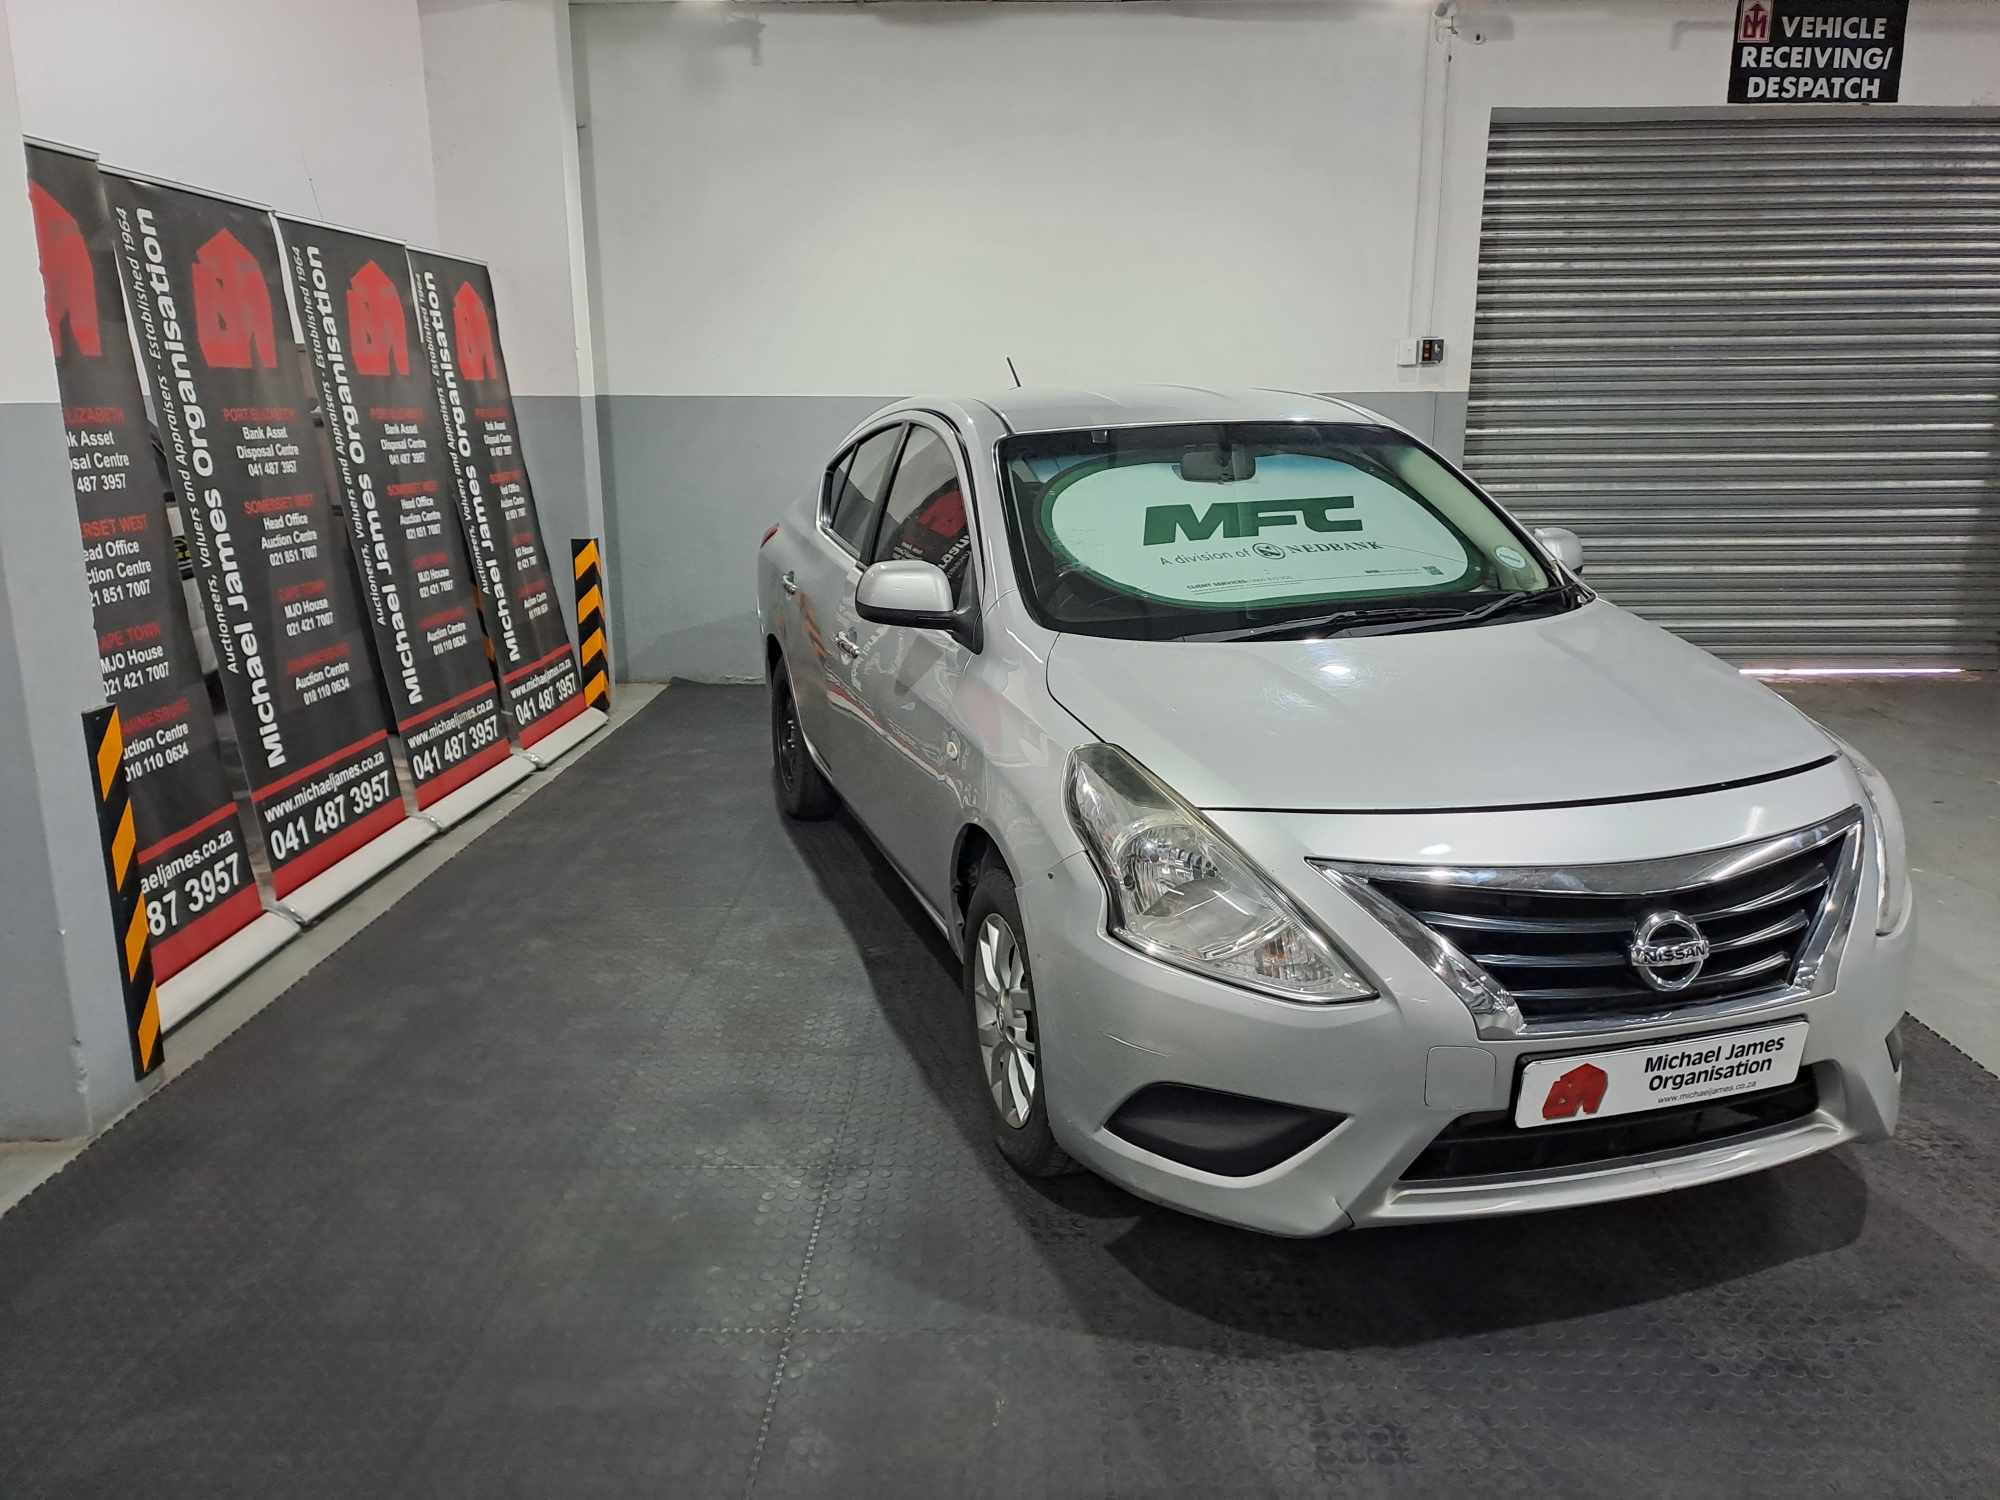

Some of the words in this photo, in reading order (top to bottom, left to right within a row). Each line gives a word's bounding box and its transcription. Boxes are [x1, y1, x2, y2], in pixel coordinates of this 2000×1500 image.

[1781, 16, 1888, 40] VEHICLE
[1740, 46, 1894, 71] RECEIVING/
[1747, 76, 1881, 99] DESPATCH
[115, 206, 136, 251] 1964
[126, 256, 162, 360] Established
[136, 206, 213, 477] Organisation
[307, 246, 365, 464] Organisation
[424, 271, 472, 458] Organisation
[158, 375, 188, 466] Appraisers
[242, 426, 266, 440] Bank
[81, 430, 115, 447] Asset
[236, 444, 274, 460] Disposal
[275, 443, 300, 457] Centre
[93, 452, 130, 468] Centre
[248, 463, 263, 477] 041
[338, 457, 354, 485] and
[76, 476, 97, 493] 487
[101, 473, 127, 491] 3957
[178, 470, 196, 503] and
[263, 514, 285, 531] Head
[285, 513, 309, 527] Office
[344, 488, 365, 539] Valuers
[466, 464, 495, 552] James
[1143, 495, 1364, 546] MFC
[190, 507, 210, 568] Valuers
[358, 473, 392, 576] James
[105, 539, 140, 558] Office
[204, 488, 249, 613] James
[261, 535, 293, 549] Auction
[1159, 556, 1172, 566] A
[1175, 550, 1234, 565] division
[1235, 548, 1252, 559] of
[1286, 541, 1384, 554] NEDBANK
[116, 560, 152, 578] Centre
[269, 552, 283, 567] 021
[102, 587, 123, 605] 851
[126, 578, 151, 598] 7007
[302, 598, 329, 615] House
[208, 574, 240, 674] Auctioneers,
[485, 559, 521, 663] Michael
[286, 621, 301, 637] 021
[381, 584, 423, 705] Michael
[100, 655, 126, 675] MJO
[126, 644, 164, 665] House
[123, 671, 144, 689] 421
[146, 661, 169, 682] 7007
[295, 671, 324, 690] Auction
[324, 661, 350, 679] Centre
[234, 622, 287, 769] Michael
[515, 697, 537, 727] 041
[538, 684, 555, 713] 487
[557, 672, 577, 701] 3957
[155, 722, 189, 745] Centre
[412, 745, 441, 780] 041
[444, 731, 467, 763] 487
[468, 714, 498, 750] 3957
[144, 754, 164, 774] 110
[165, 742, 189, 765] 0634
[263, 751, 385, 823] www.michaeljames.co.za
[270, 815, 310, 860] 041
[314, 793, 346, 835] 487
[349, 769, 390, 815] 3957
[184, 852, 241, 913] 3957
[1644, 946, 1706, 963] NISSAN
[1644, 1046, 1722, 1073] Michael
[1724, 1037, 1785, 1061] James
[1648, 1058, 1773, 1092] Organisation
